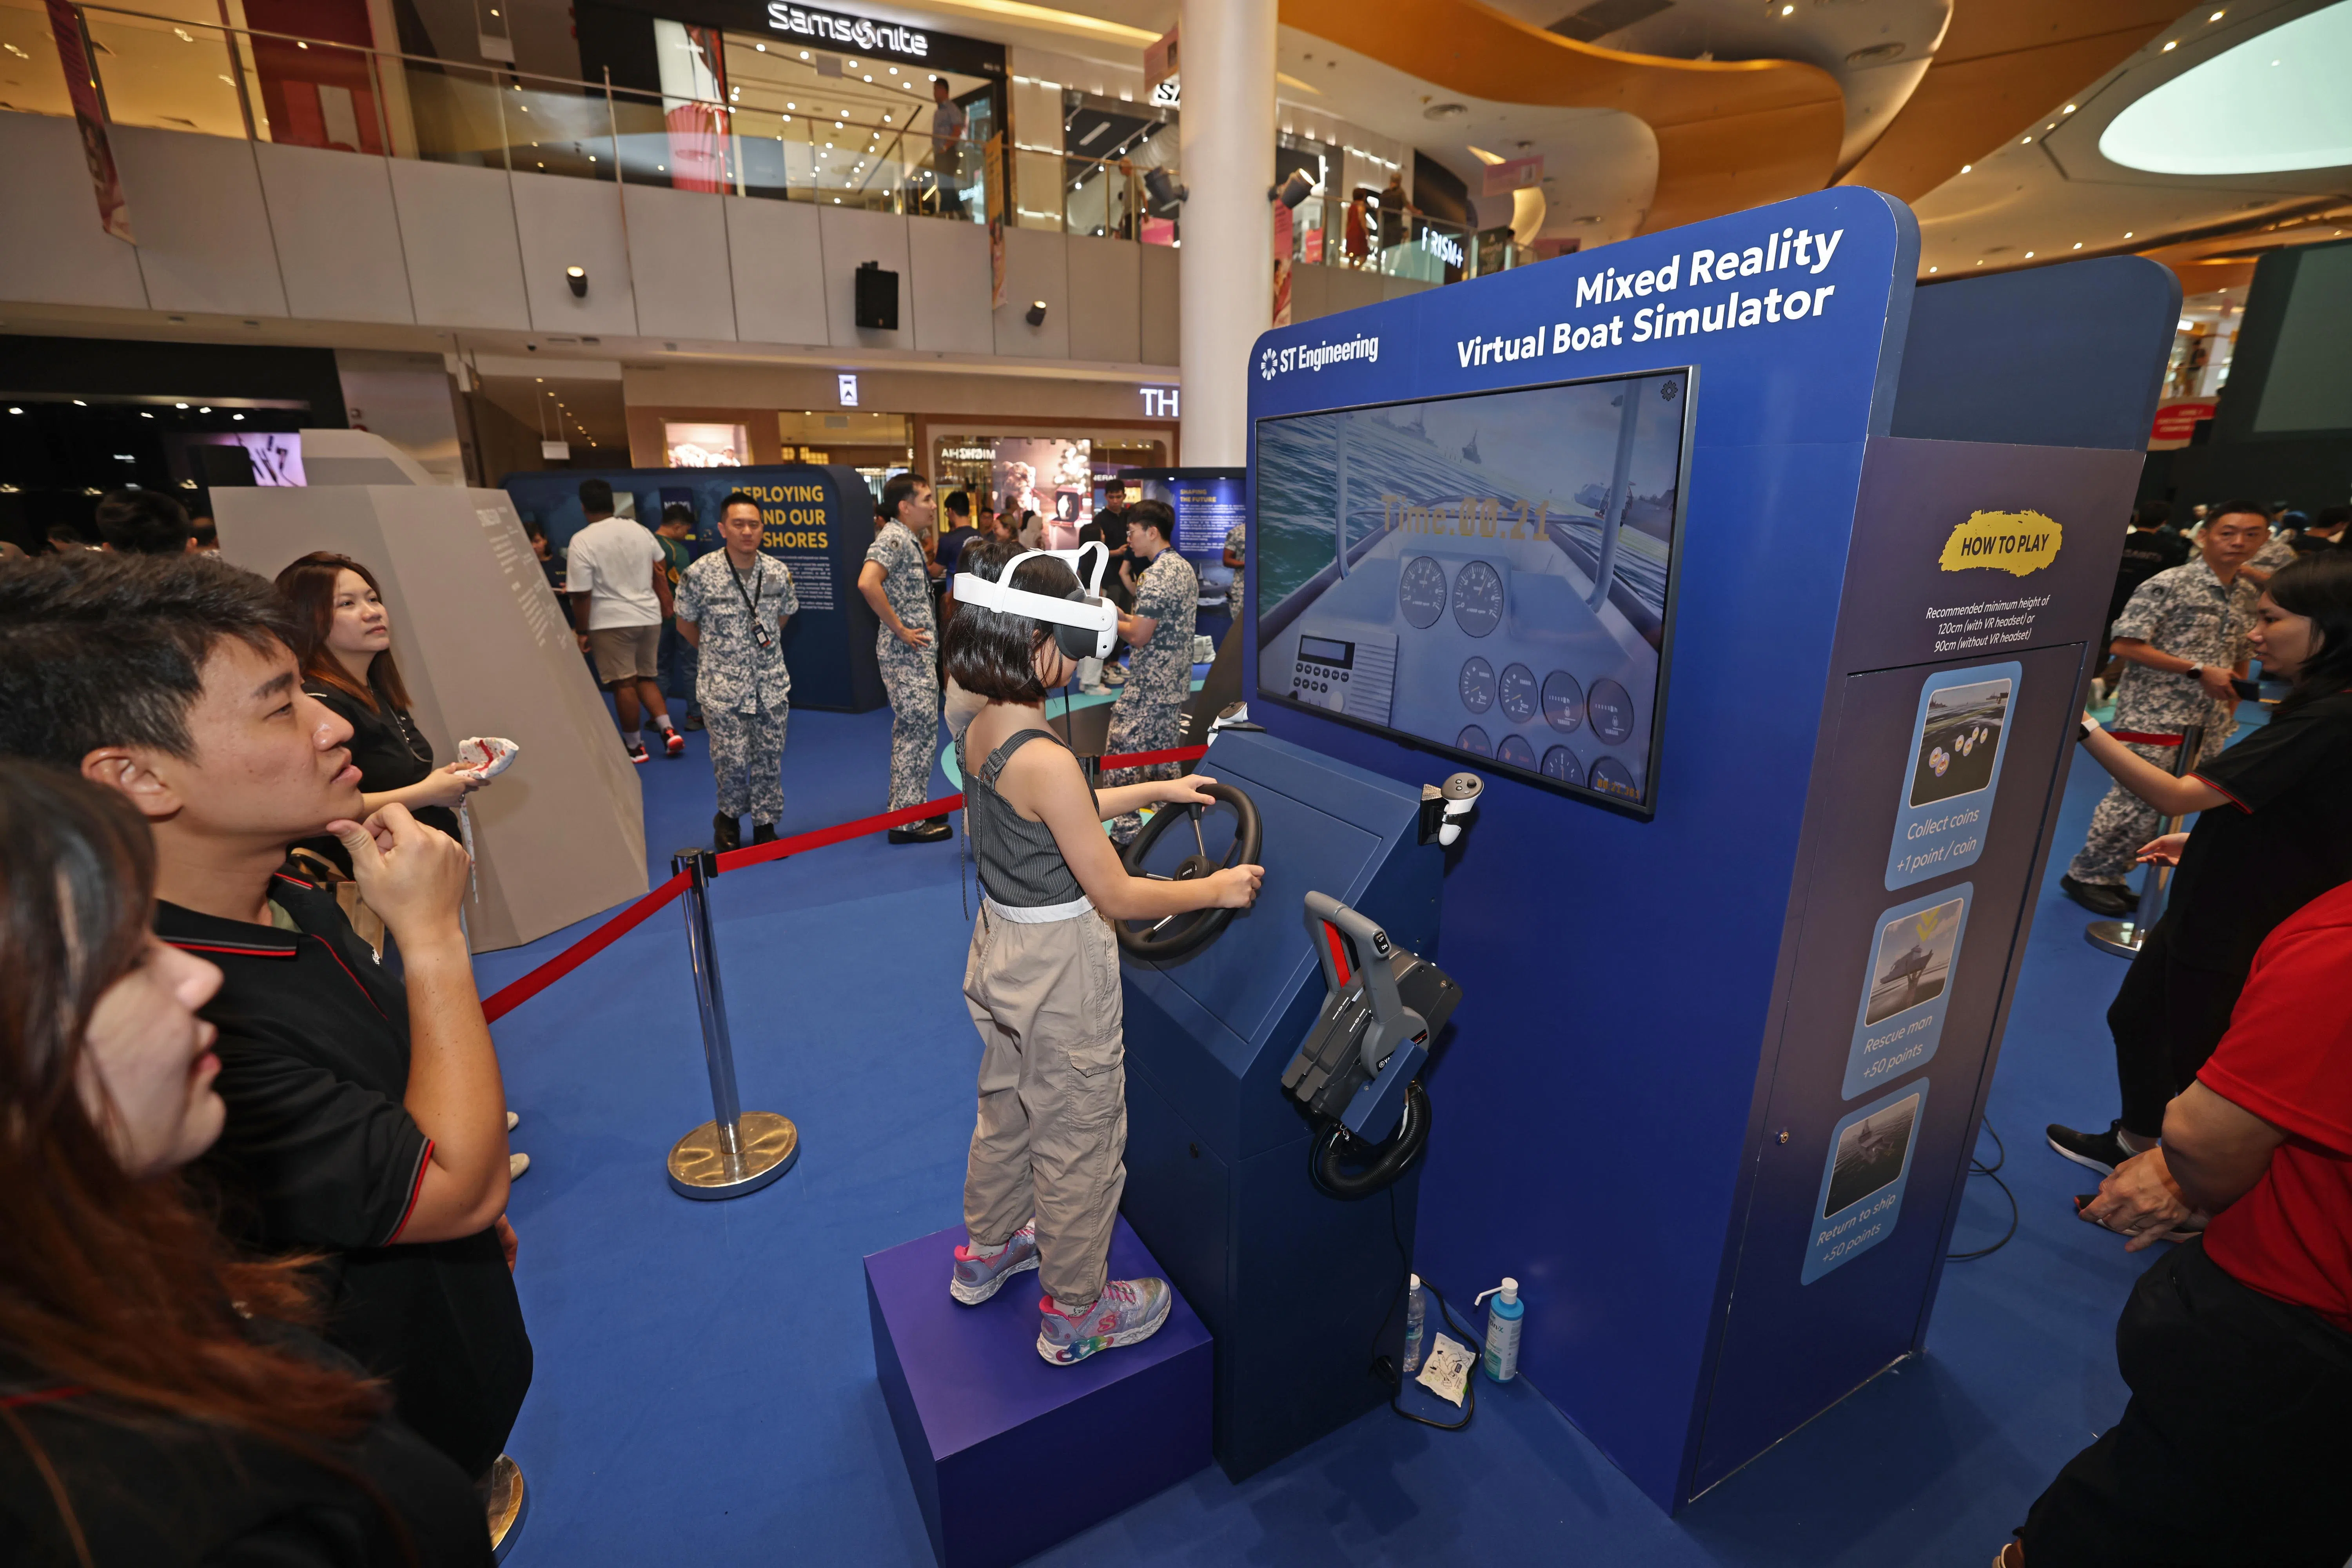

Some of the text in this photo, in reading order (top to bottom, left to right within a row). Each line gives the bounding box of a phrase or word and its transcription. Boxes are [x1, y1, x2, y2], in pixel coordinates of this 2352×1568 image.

[767, 0, 928, 56] Samsonite
[1575, 227, 1844, 308] Mixed Reality
[1457, 285, 1835, 368] Virtual Boat Simulator
[1280, 333, 1379, 372] ST Engineering
[789, 508, 826, 526] OUR
[763, 532, 829, 548] SHORES
[1961, 533, 2050, 556] HOW TO PLAY
[1926, 595, 2051, 619] Recommended minimum height of
[1938, 612, 2035, 635] 120cm (with VR headset) or
[1934, 628, 2032, 652] 90cm (without VR headset)
[1907, 809, 1980, 840] Collect coins
[1897, 837, 1976, 873] +1 point / coin
[1864, 1016, 1933, 1054] Rescue man
[1864, 1044, 1923, 1077] +50 points
[1817, 1194, 1896, 1247] Return to ship
[1823, 1223, 1882, 1262] +50 points
